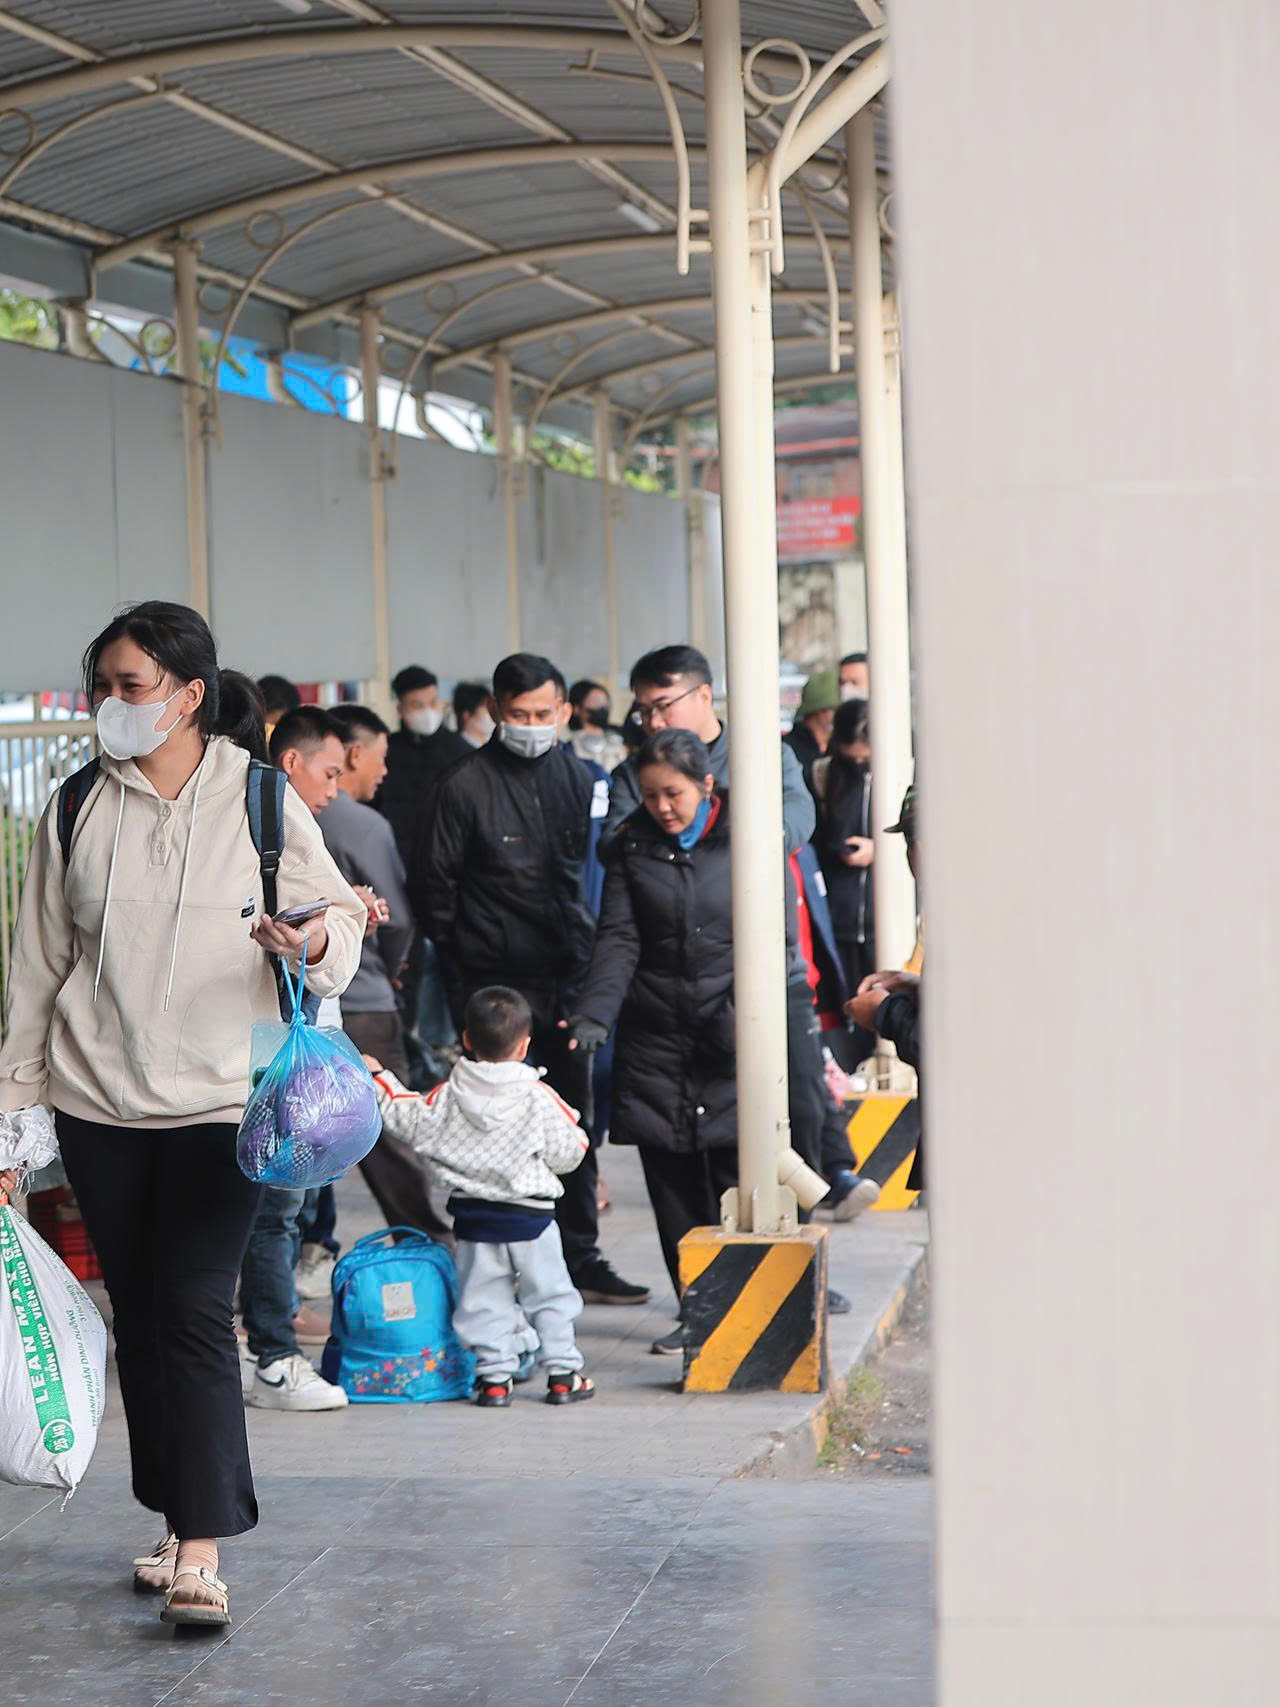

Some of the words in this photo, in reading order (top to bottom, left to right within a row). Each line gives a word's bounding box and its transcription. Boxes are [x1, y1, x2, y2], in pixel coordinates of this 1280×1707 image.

[17, 1261, 32, 1286] CHO
[6, 1271, 29, 1326] MAX
[26, 1289, 43, 1320] VIÊN
[38, 1323, 51, 1349] HỢP
[77, 1342, 88, 1365] DINH
[23, 1335, 50, 1404] LEAN
[53, 1438, 68, 1450] 25
